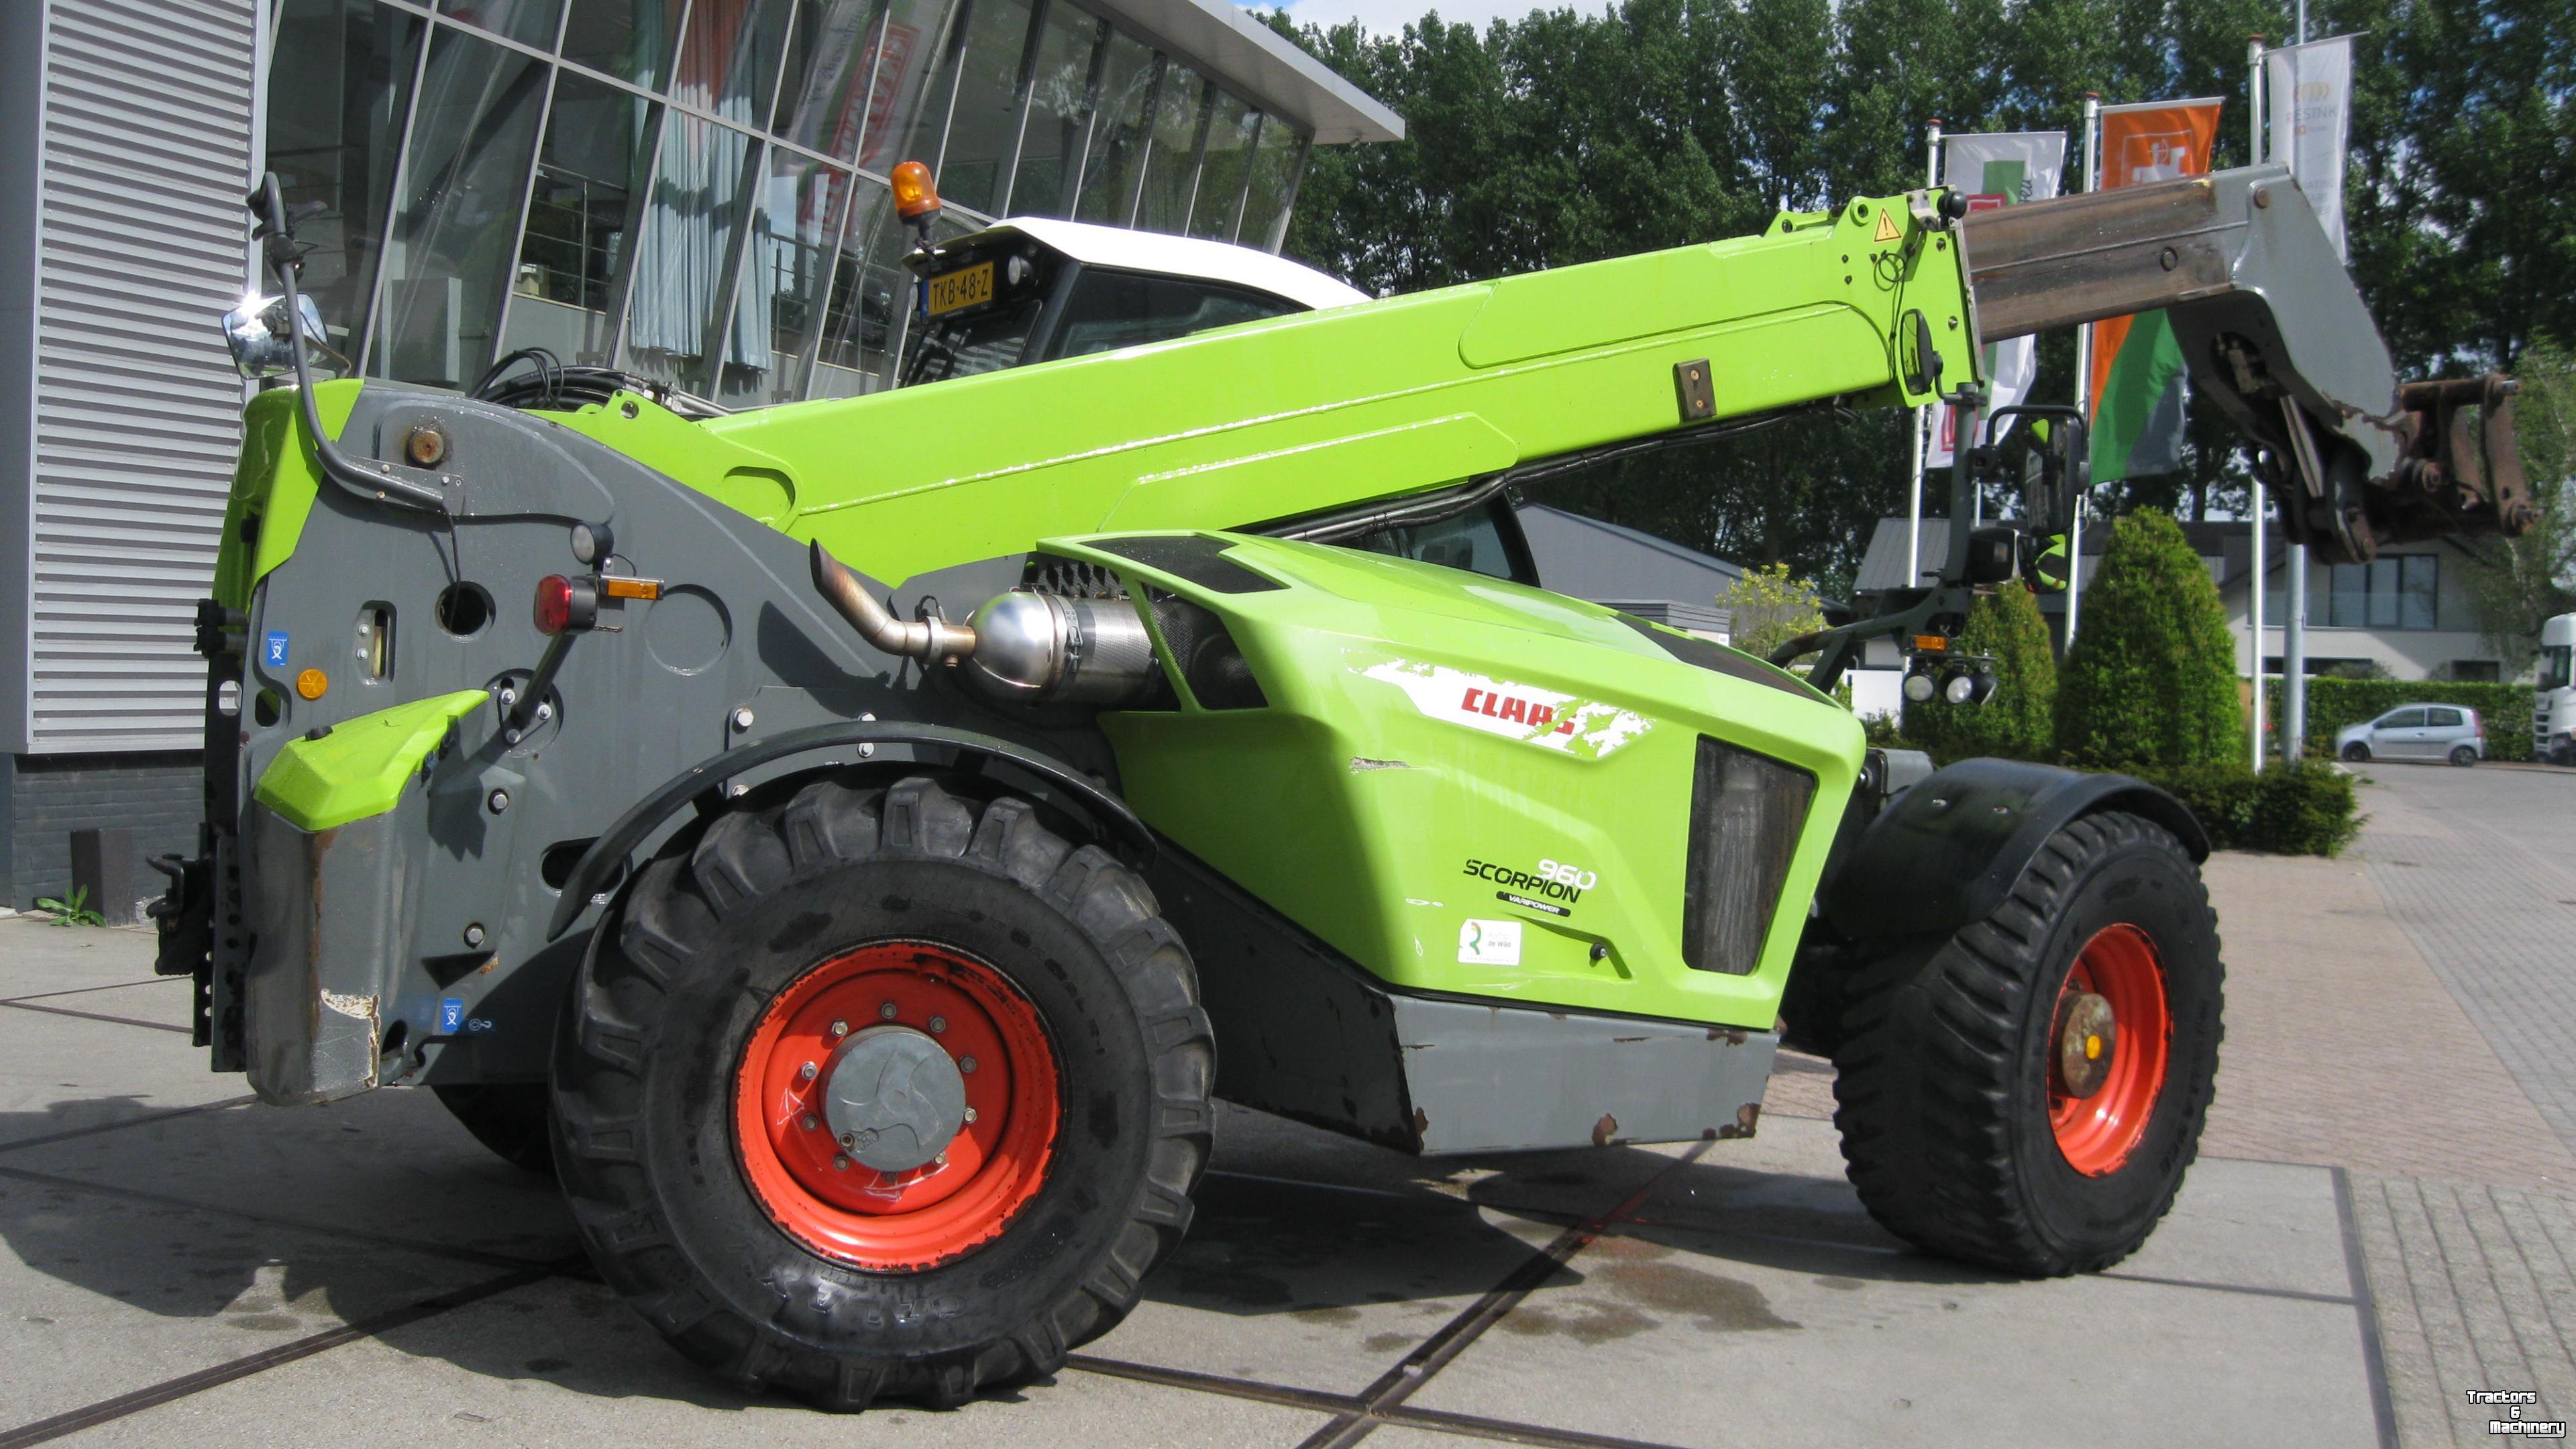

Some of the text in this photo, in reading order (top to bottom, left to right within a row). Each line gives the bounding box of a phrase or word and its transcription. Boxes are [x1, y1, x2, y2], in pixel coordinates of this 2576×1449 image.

[1463, 859, 1582, 904] SCORPION
[1536, 859, 1597, 890] 960
[1509, 894, 1560, 914] VARIPOWER
